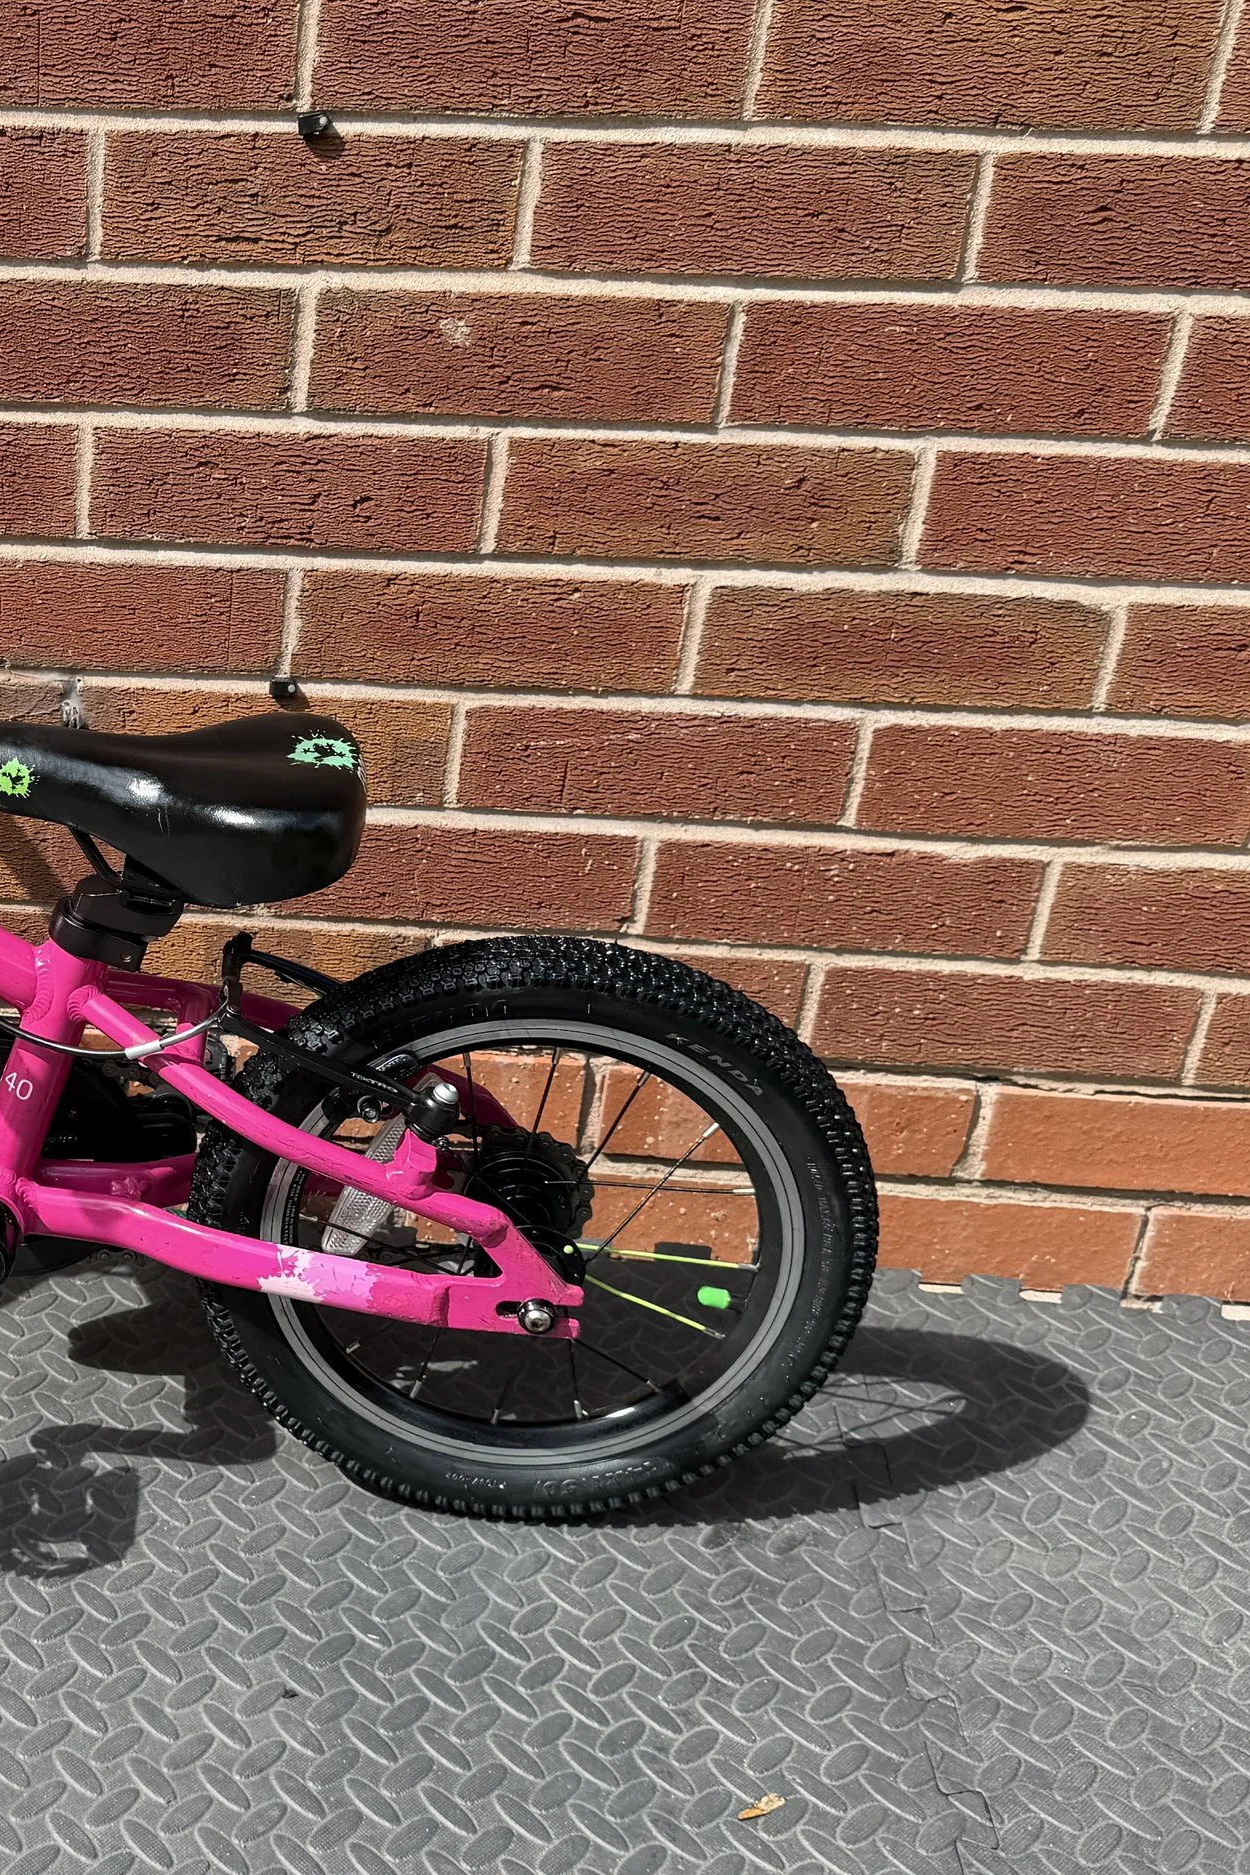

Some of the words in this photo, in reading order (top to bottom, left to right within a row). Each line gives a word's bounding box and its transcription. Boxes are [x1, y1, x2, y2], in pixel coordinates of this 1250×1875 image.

[663, 1031, 765, 1097] KENDA
[3, 1070, 35, 1102] 40
[350, 1070, 400, 1094] TEKTRO
